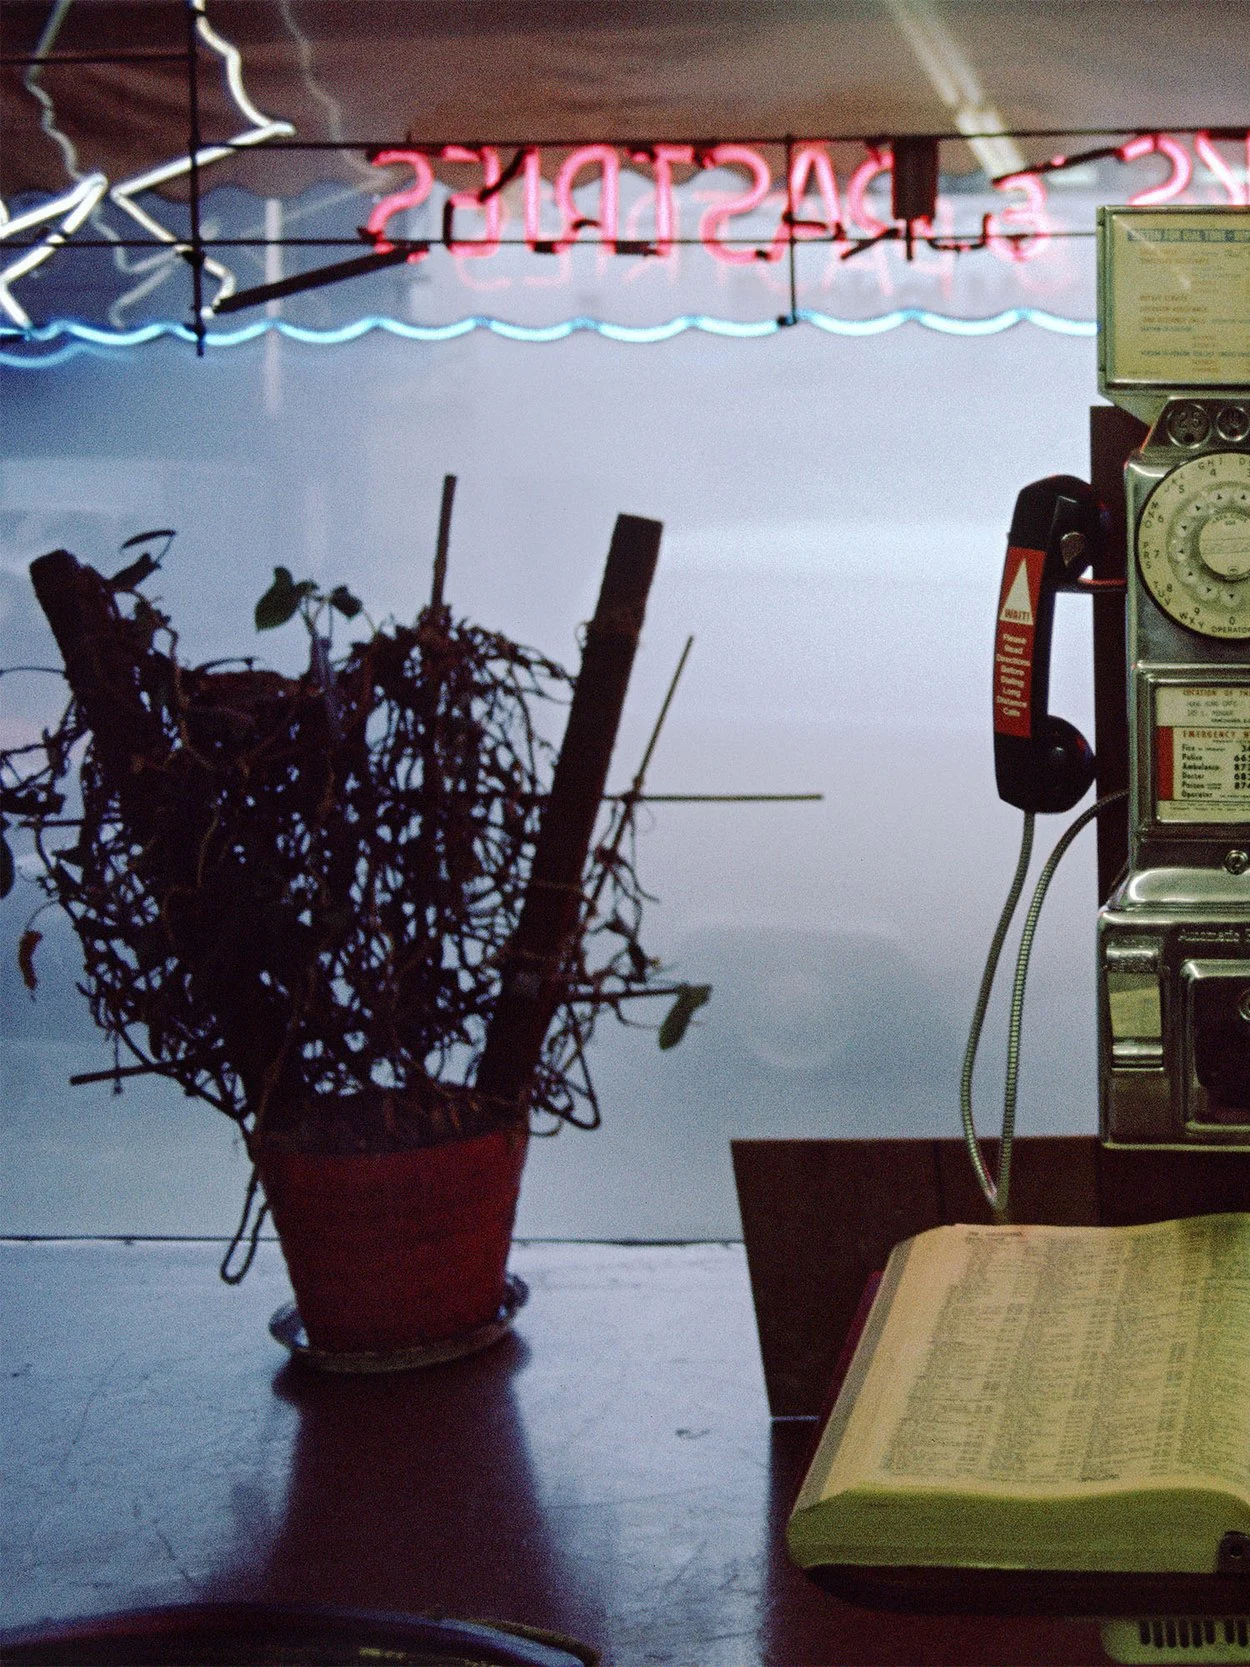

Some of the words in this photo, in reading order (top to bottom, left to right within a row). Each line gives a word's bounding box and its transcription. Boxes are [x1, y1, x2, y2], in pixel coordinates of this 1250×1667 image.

[1182, 689, 1217, 697] LOCATION
[1182, 753, 1203, 761] Police
[1181, 790, 1213, 798] Operator
